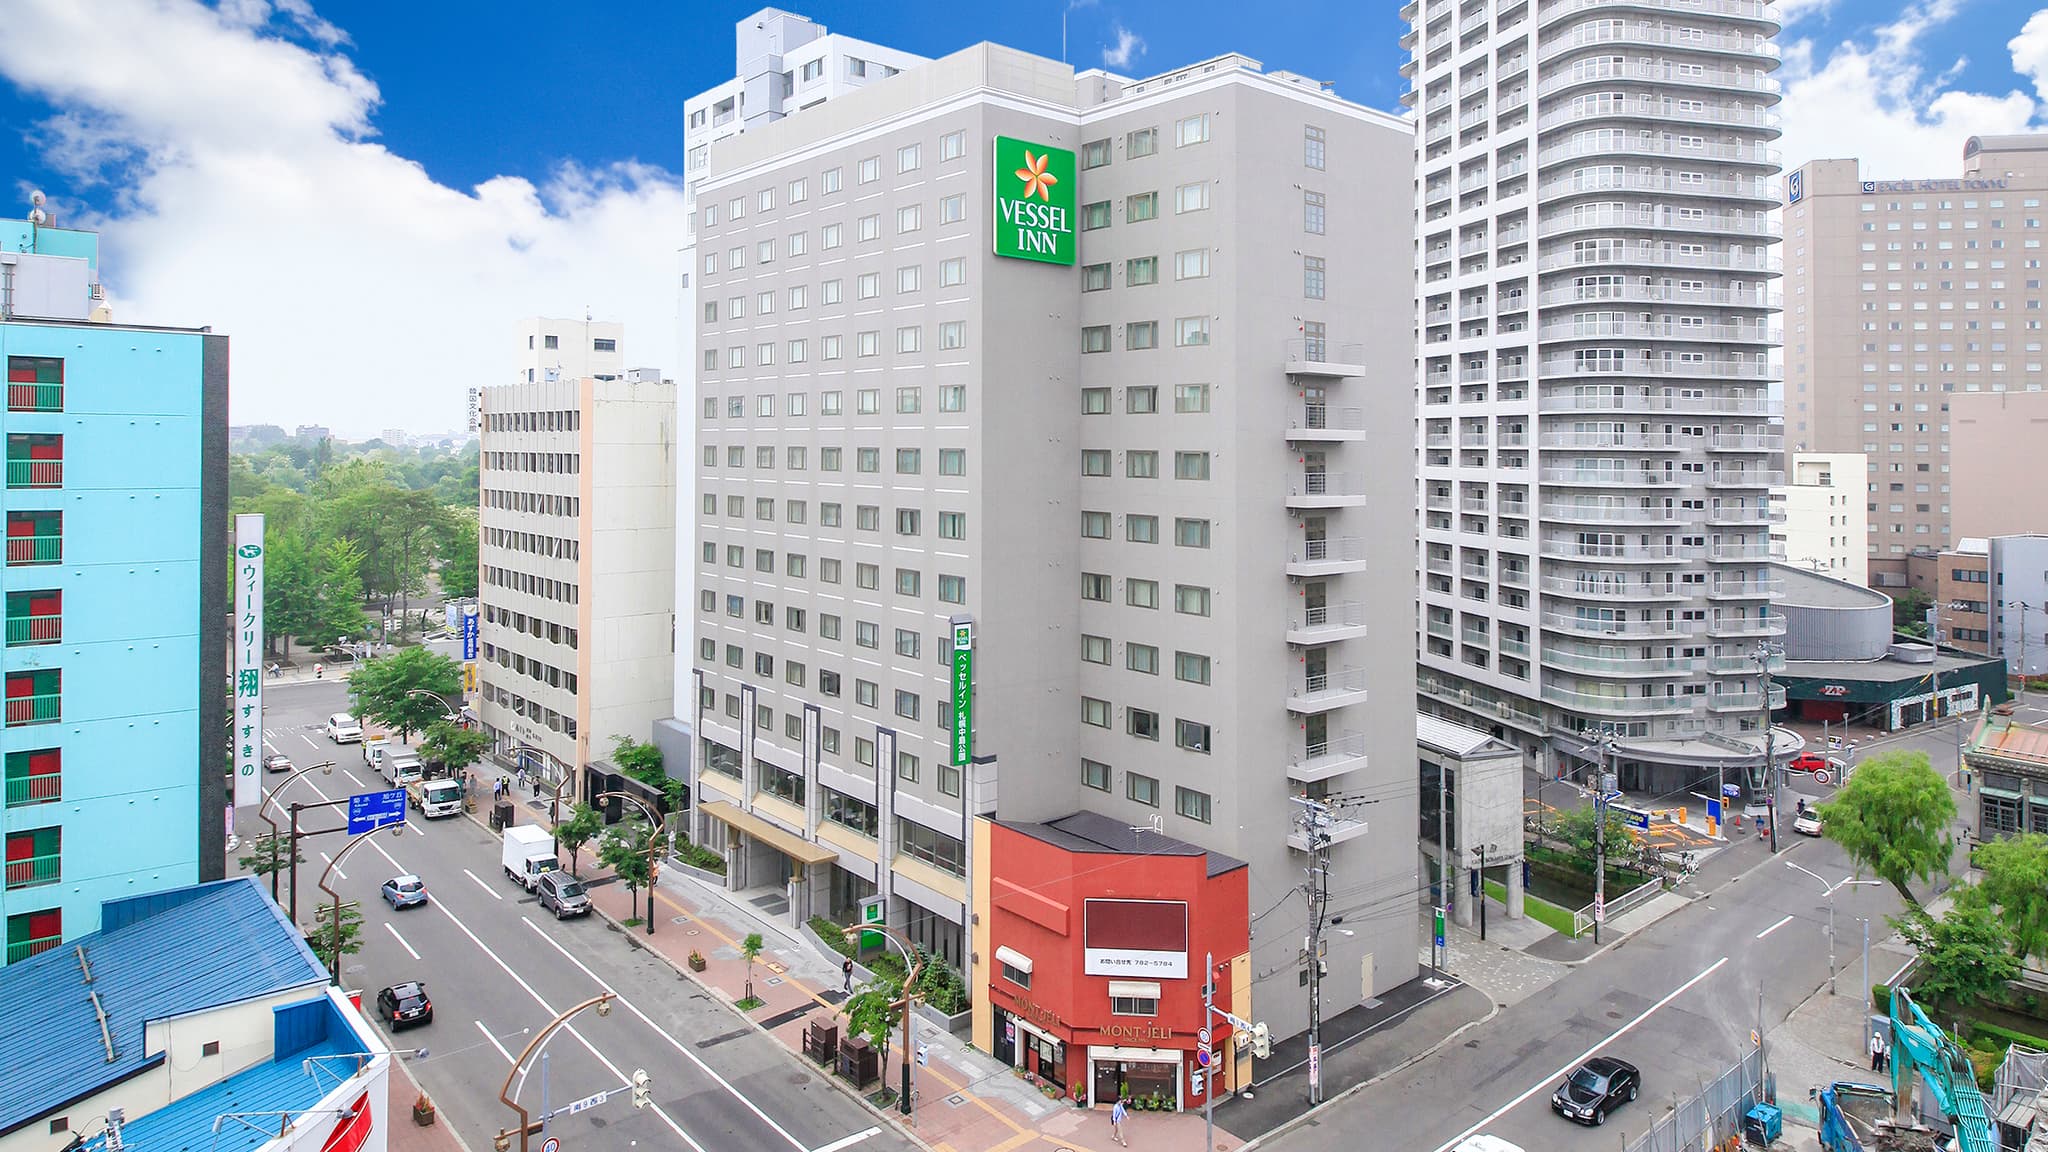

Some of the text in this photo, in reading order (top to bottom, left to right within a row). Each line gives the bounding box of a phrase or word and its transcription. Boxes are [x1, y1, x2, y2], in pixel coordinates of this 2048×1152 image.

[1878, 178, 2008, 192] EXCEL HOTEL TOKYU
[999, 196, 1072, 233] VESSEL
[1018, 228, 1057, 256] INN
